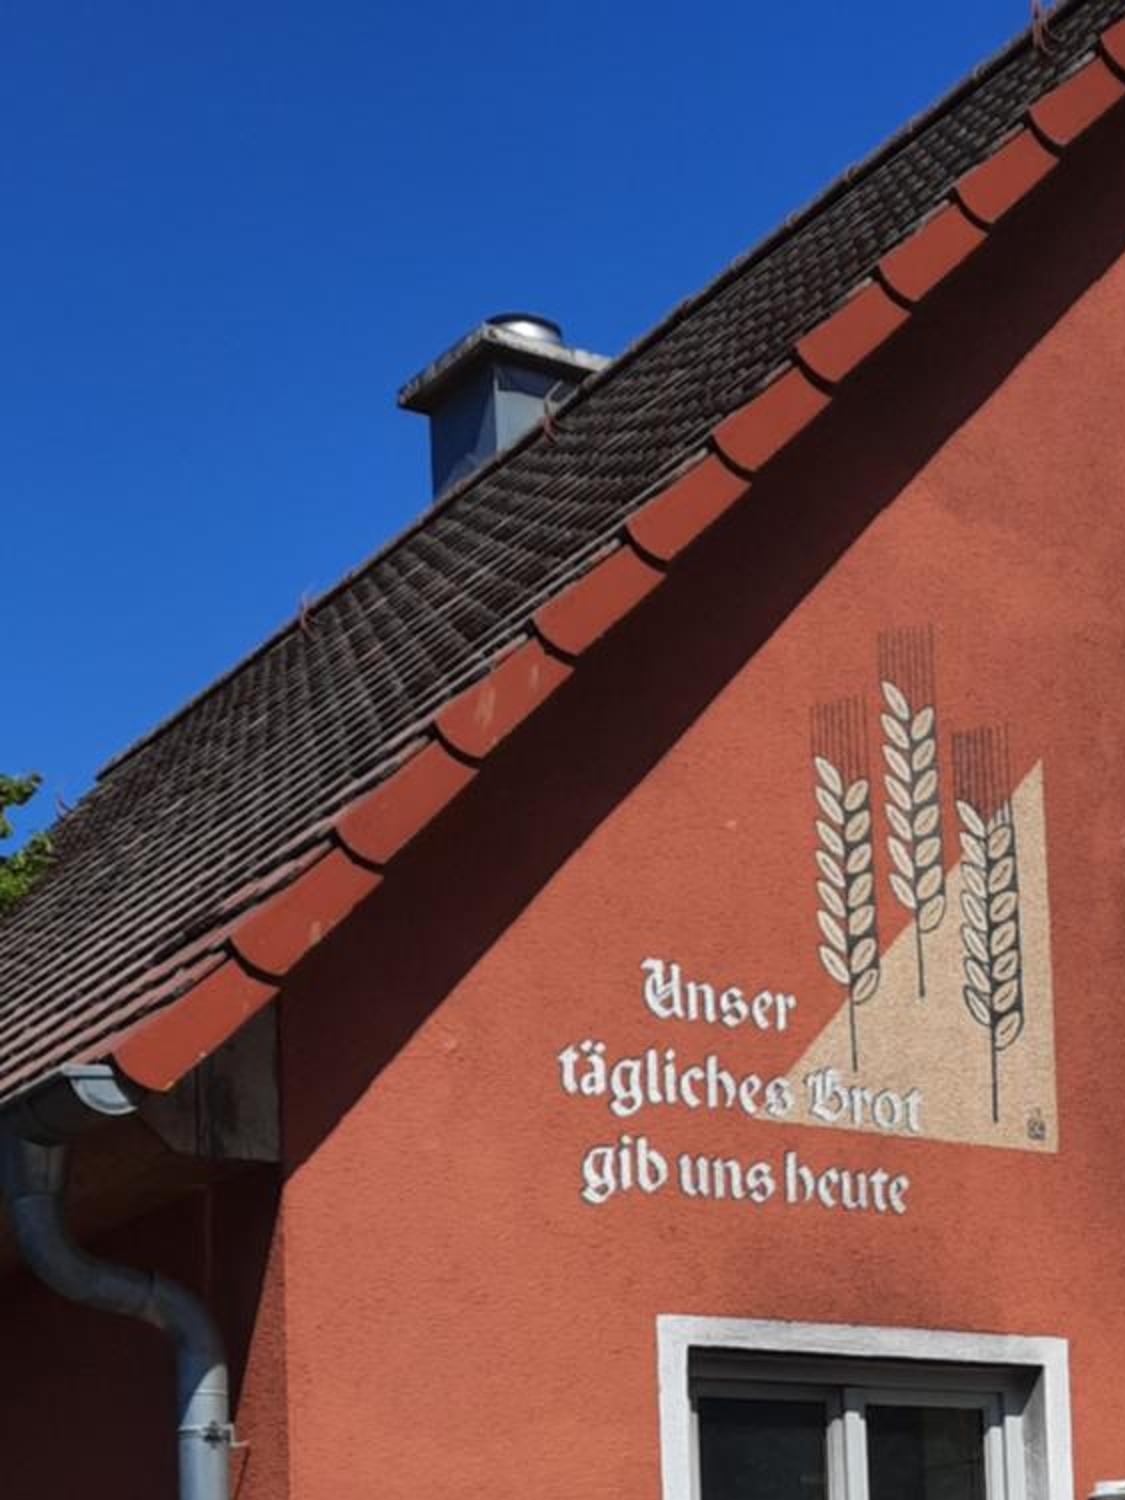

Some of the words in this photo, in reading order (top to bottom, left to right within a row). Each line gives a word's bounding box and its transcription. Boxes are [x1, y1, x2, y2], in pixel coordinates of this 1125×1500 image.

[641, 957, 797, 1031] Unser
[557, 1039, 795, 1118] tägliches
[805, 1067, 923, 1132] Brot
[581, 1134, 669, 1204] gib
[679, 1152, 776, 1203] uns
[785, 1151, 910, 1214] heute
